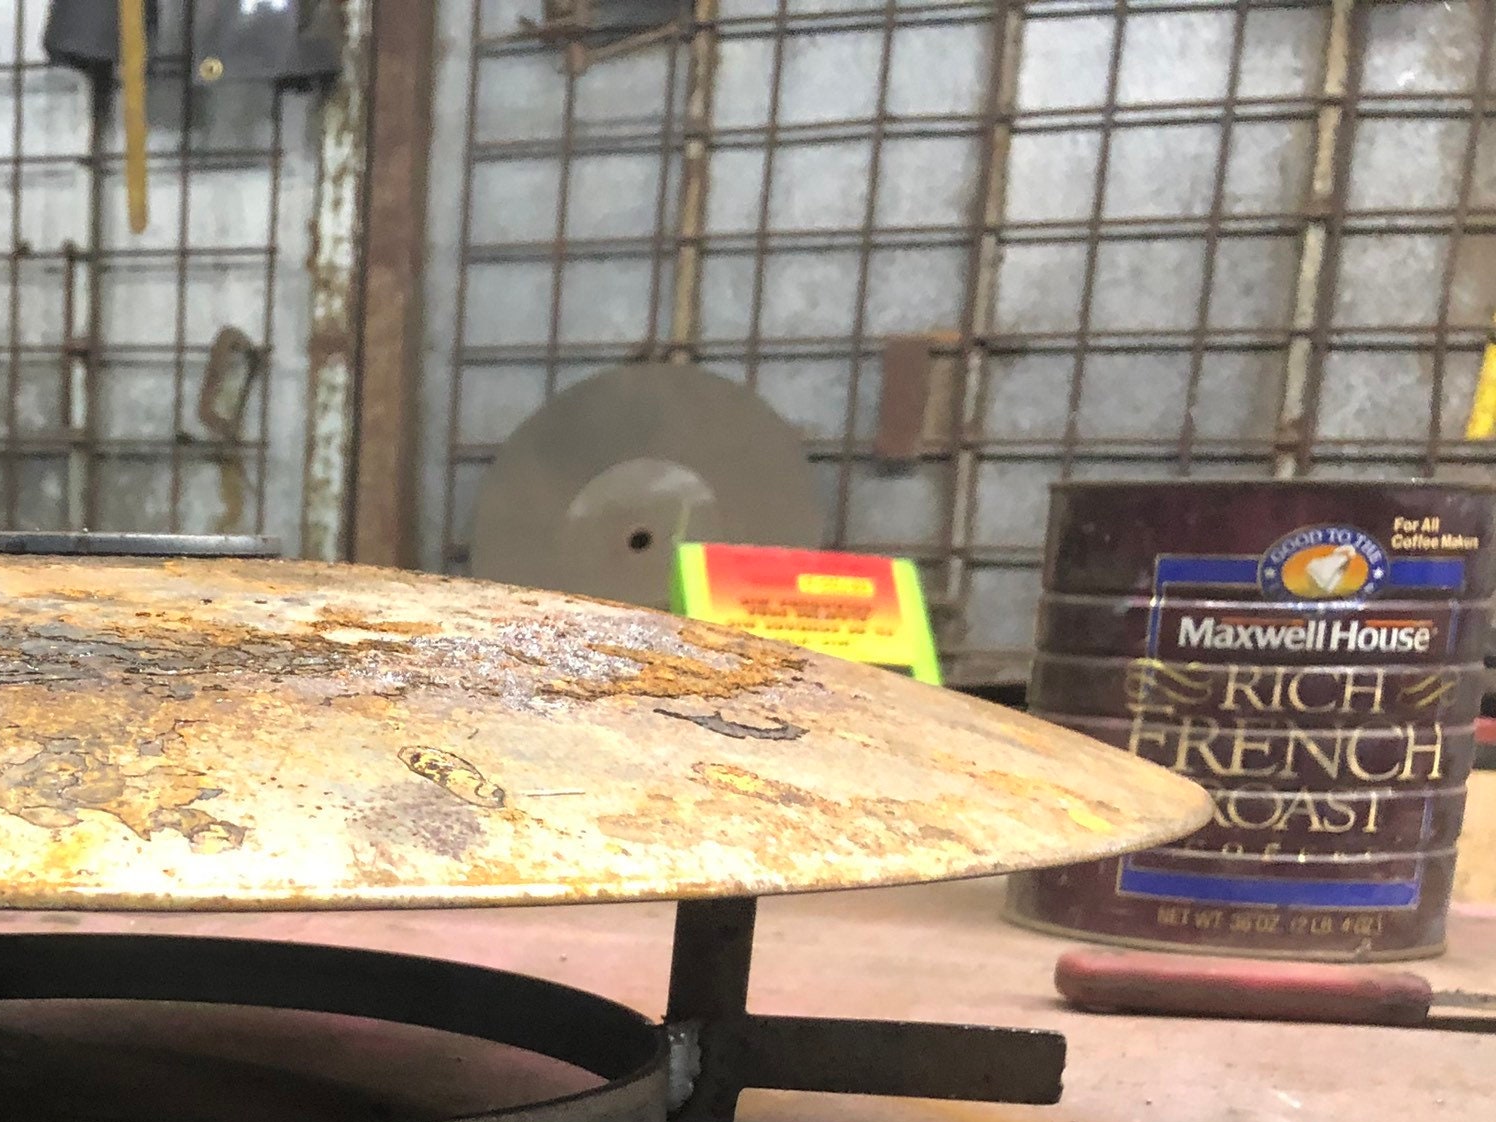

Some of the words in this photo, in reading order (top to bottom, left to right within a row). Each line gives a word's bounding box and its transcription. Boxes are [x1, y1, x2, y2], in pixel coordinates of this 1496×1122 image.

[1391, 533, 1439, 551] Coffee
[1393, 516, 1419, 534] For
[1421, 516, 1441, 534] All
[1178, 616, 1327, 650] Maxwell
[1330, 619, 1431, 652] House
[1219, 664, 1386, 714] RICH
[1126, 703, 1442, 781] FRENCH
